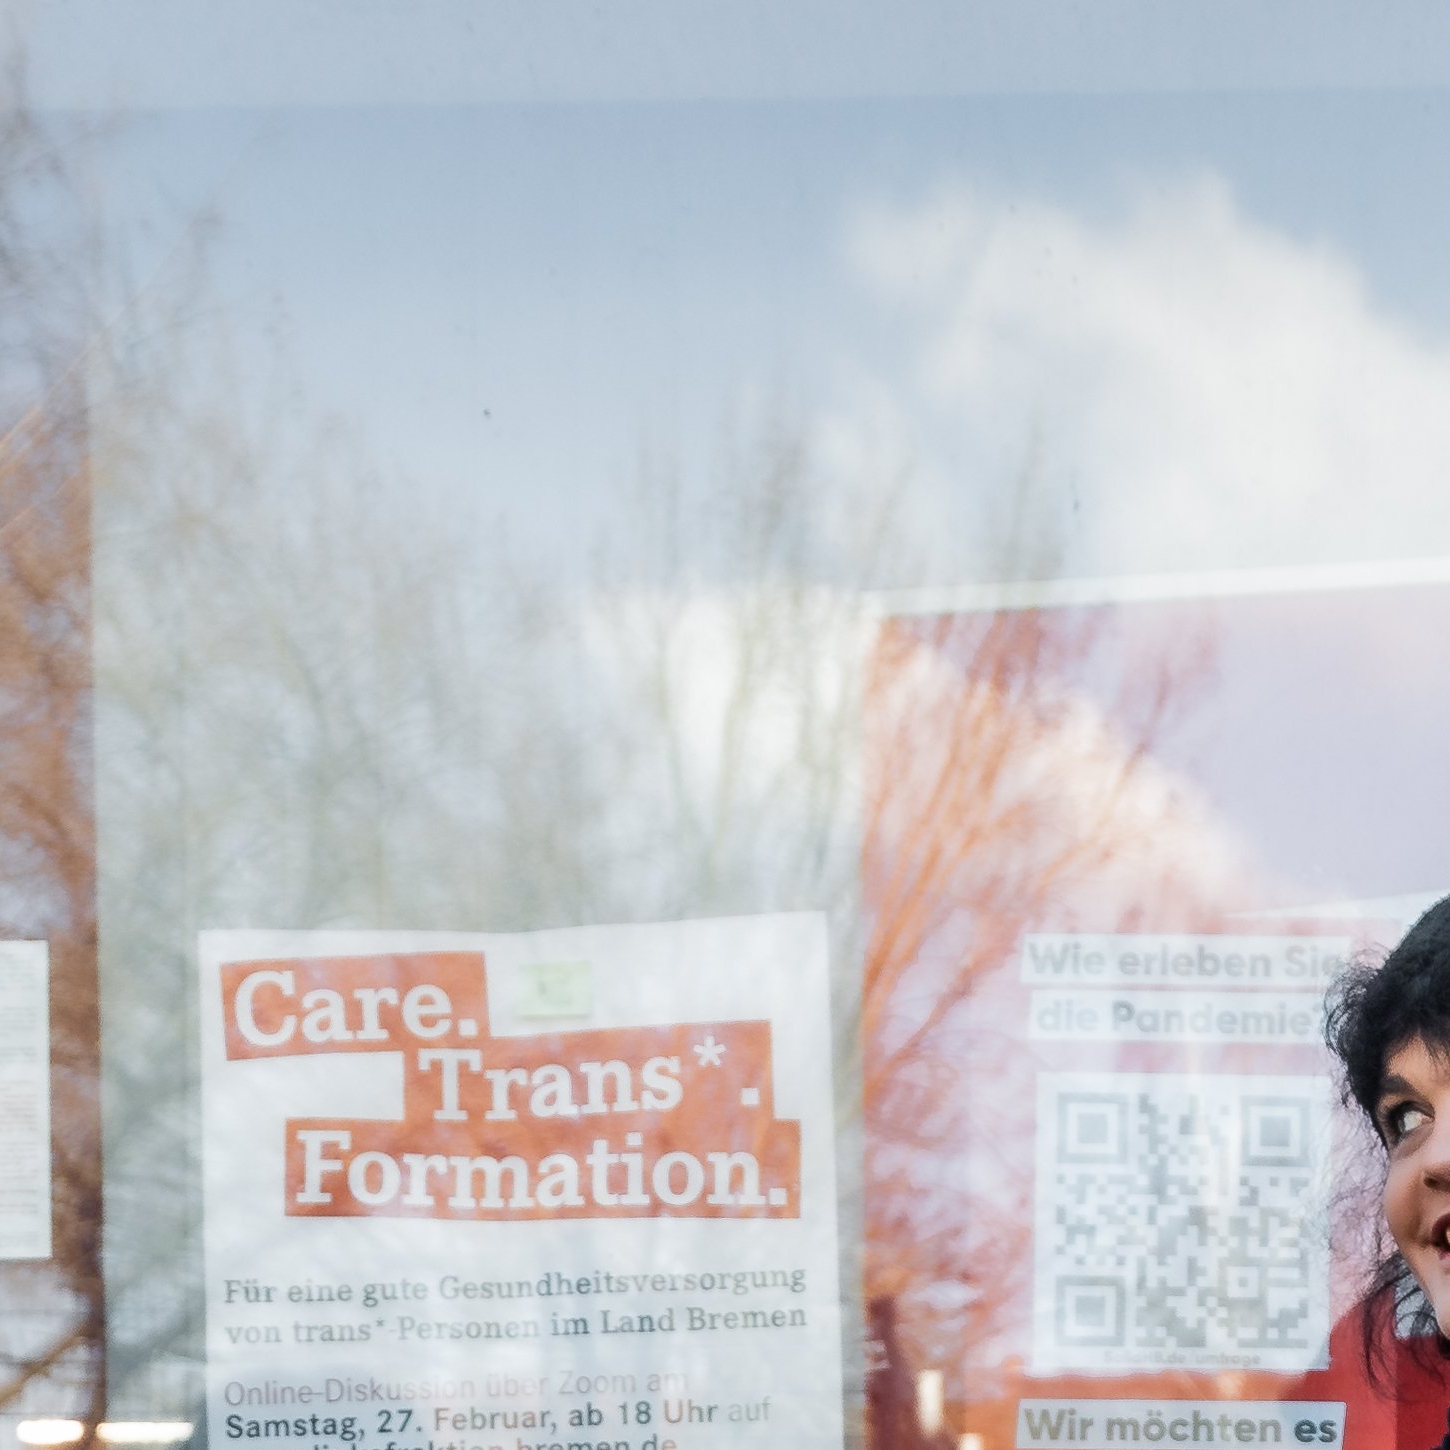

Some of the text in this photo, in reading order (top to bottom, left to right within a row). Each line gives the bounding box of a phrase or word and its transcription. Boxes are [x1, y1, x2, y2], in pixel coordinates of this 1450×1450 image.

[1027, 941, 1346, 979] Wie erleben Sie
[234, 970, 477, 1047] Care.
[1037, 1000, 1098, 1034] die
[295, 1131, 788, 1207] Formation.
[224, 1267, 808, 1307] Für eine gute Gesundheitsversorgung
[225, 1322, 283, 1344] von
[551, 1312, 590, 1336] im
[600, 1309, 676, 1334] Land
[686, 1306, 808, 1331] Bremen
[225, 1375, 476, 1406] Online-Diskussion
[485, 1373, 547, 1398] über
[558, 1371, 637, 1396] Zoom
[225, 1397, 772, 1441] Samstag, 27. Februar, ab 18 Uhr auf
[1026, 1403, 1338, 1444] Wir möchten es
